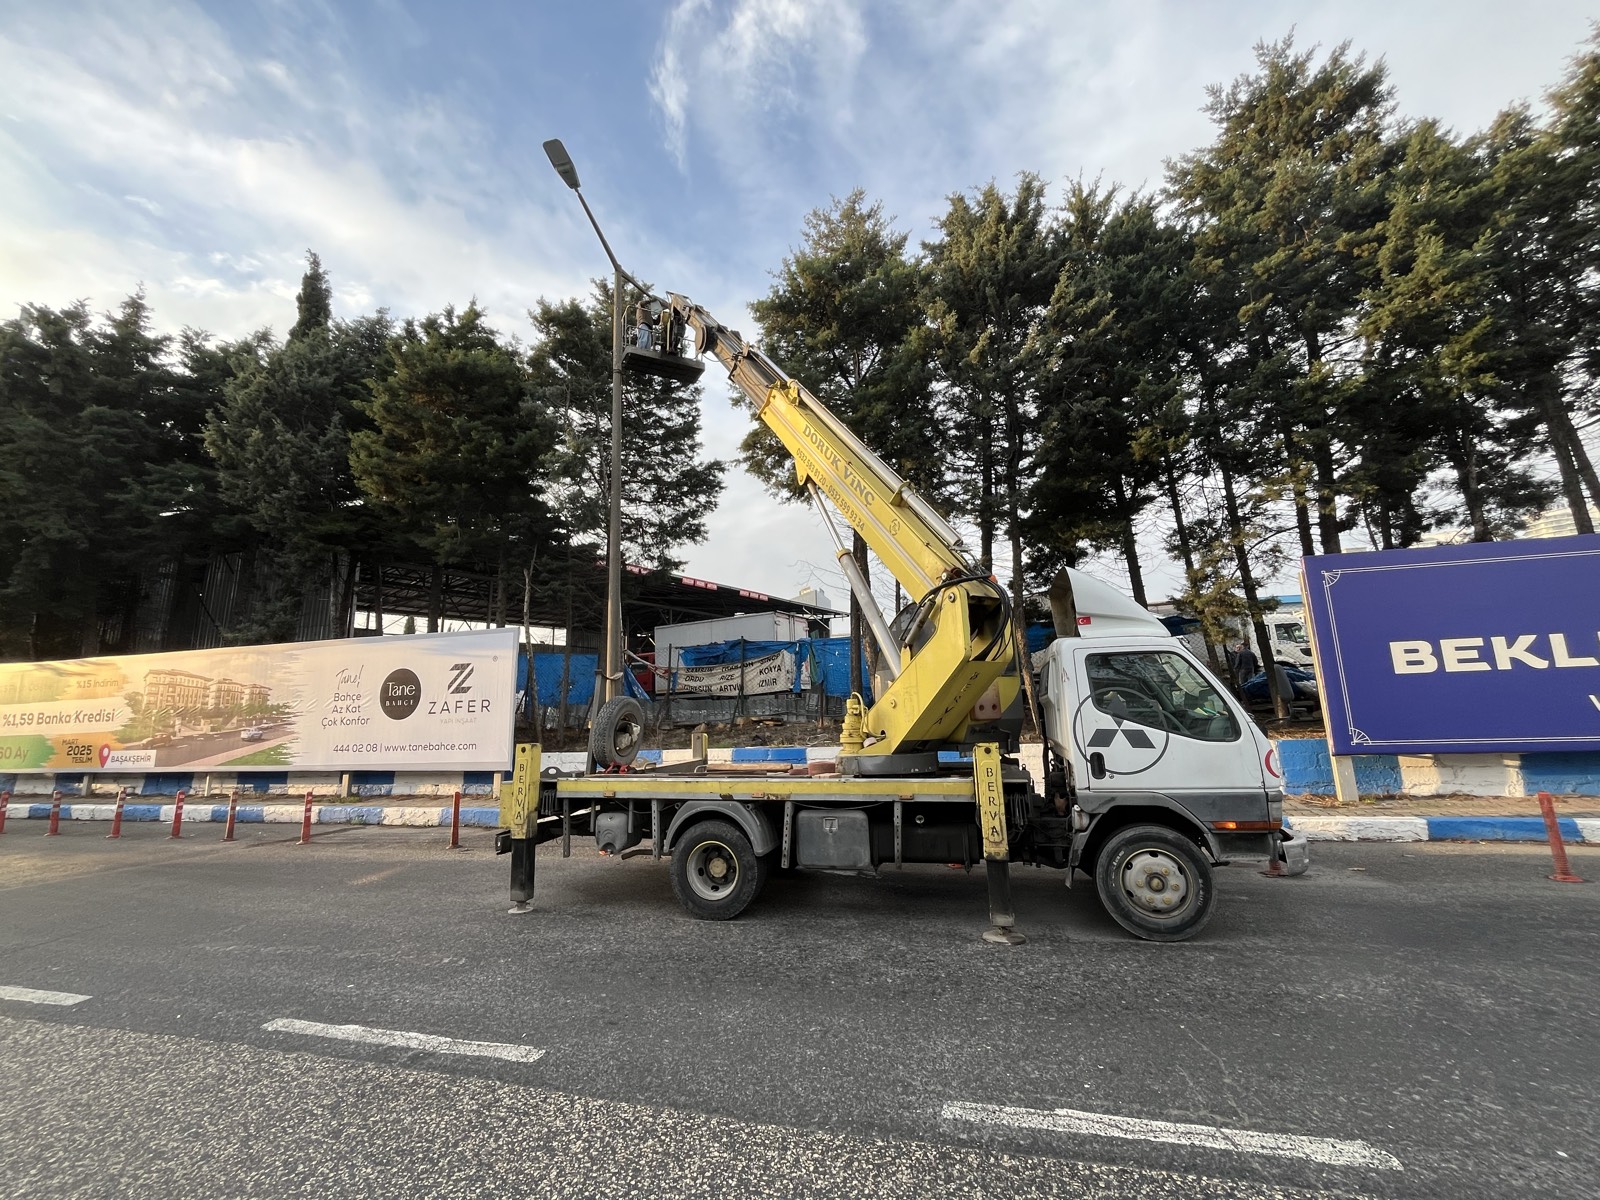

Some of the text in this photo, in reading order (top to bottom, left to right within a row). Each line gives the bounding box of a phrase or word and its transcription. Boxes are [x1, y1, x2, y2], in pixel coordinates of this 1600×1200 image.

[802, 424, 841, 471] DORUK
[796, 447, 807, 464] 0532
[818, 476, 827, 486] 20
[828, 485, 841, 503] 0532
[840, 501, 849, 514] 599
[849, 511, 858, 523] 93
[856, 519, 865, 532] 34
[1389, 631, 1600, 675] BEKL
[336, 664, 364, 690] Tane!
[760, 664, 782, 675] KONYA
[76, 679, 92, 689] %15
[387, 681, 416, 697] Tane
[333, 692, 362, 702] Bahçe
[332, 704, 361, 714] Az Kat
[428, 699, 491, 715] ZAFER
[2, 708, 115, 728] %1,59 Banka Kredisi
[321, 716, 370, 729] Çok Konfor
[61, 738, 79, 746] MART
[333, 744, 350, 753] 444
[352, 744, 364, 753] 02
[366, 743, 378, 753] 08
[384, 742, 477, 753] www.tanebahce.com
[13, 746, 30, 764] Ay
[67, 745, 93, 756] 2025
[111, 753, 152, 765] BAŞAKŞEHİR
[515, 763, 525, 820] BERVA
[985, 767, 1000, 837] BERVA
